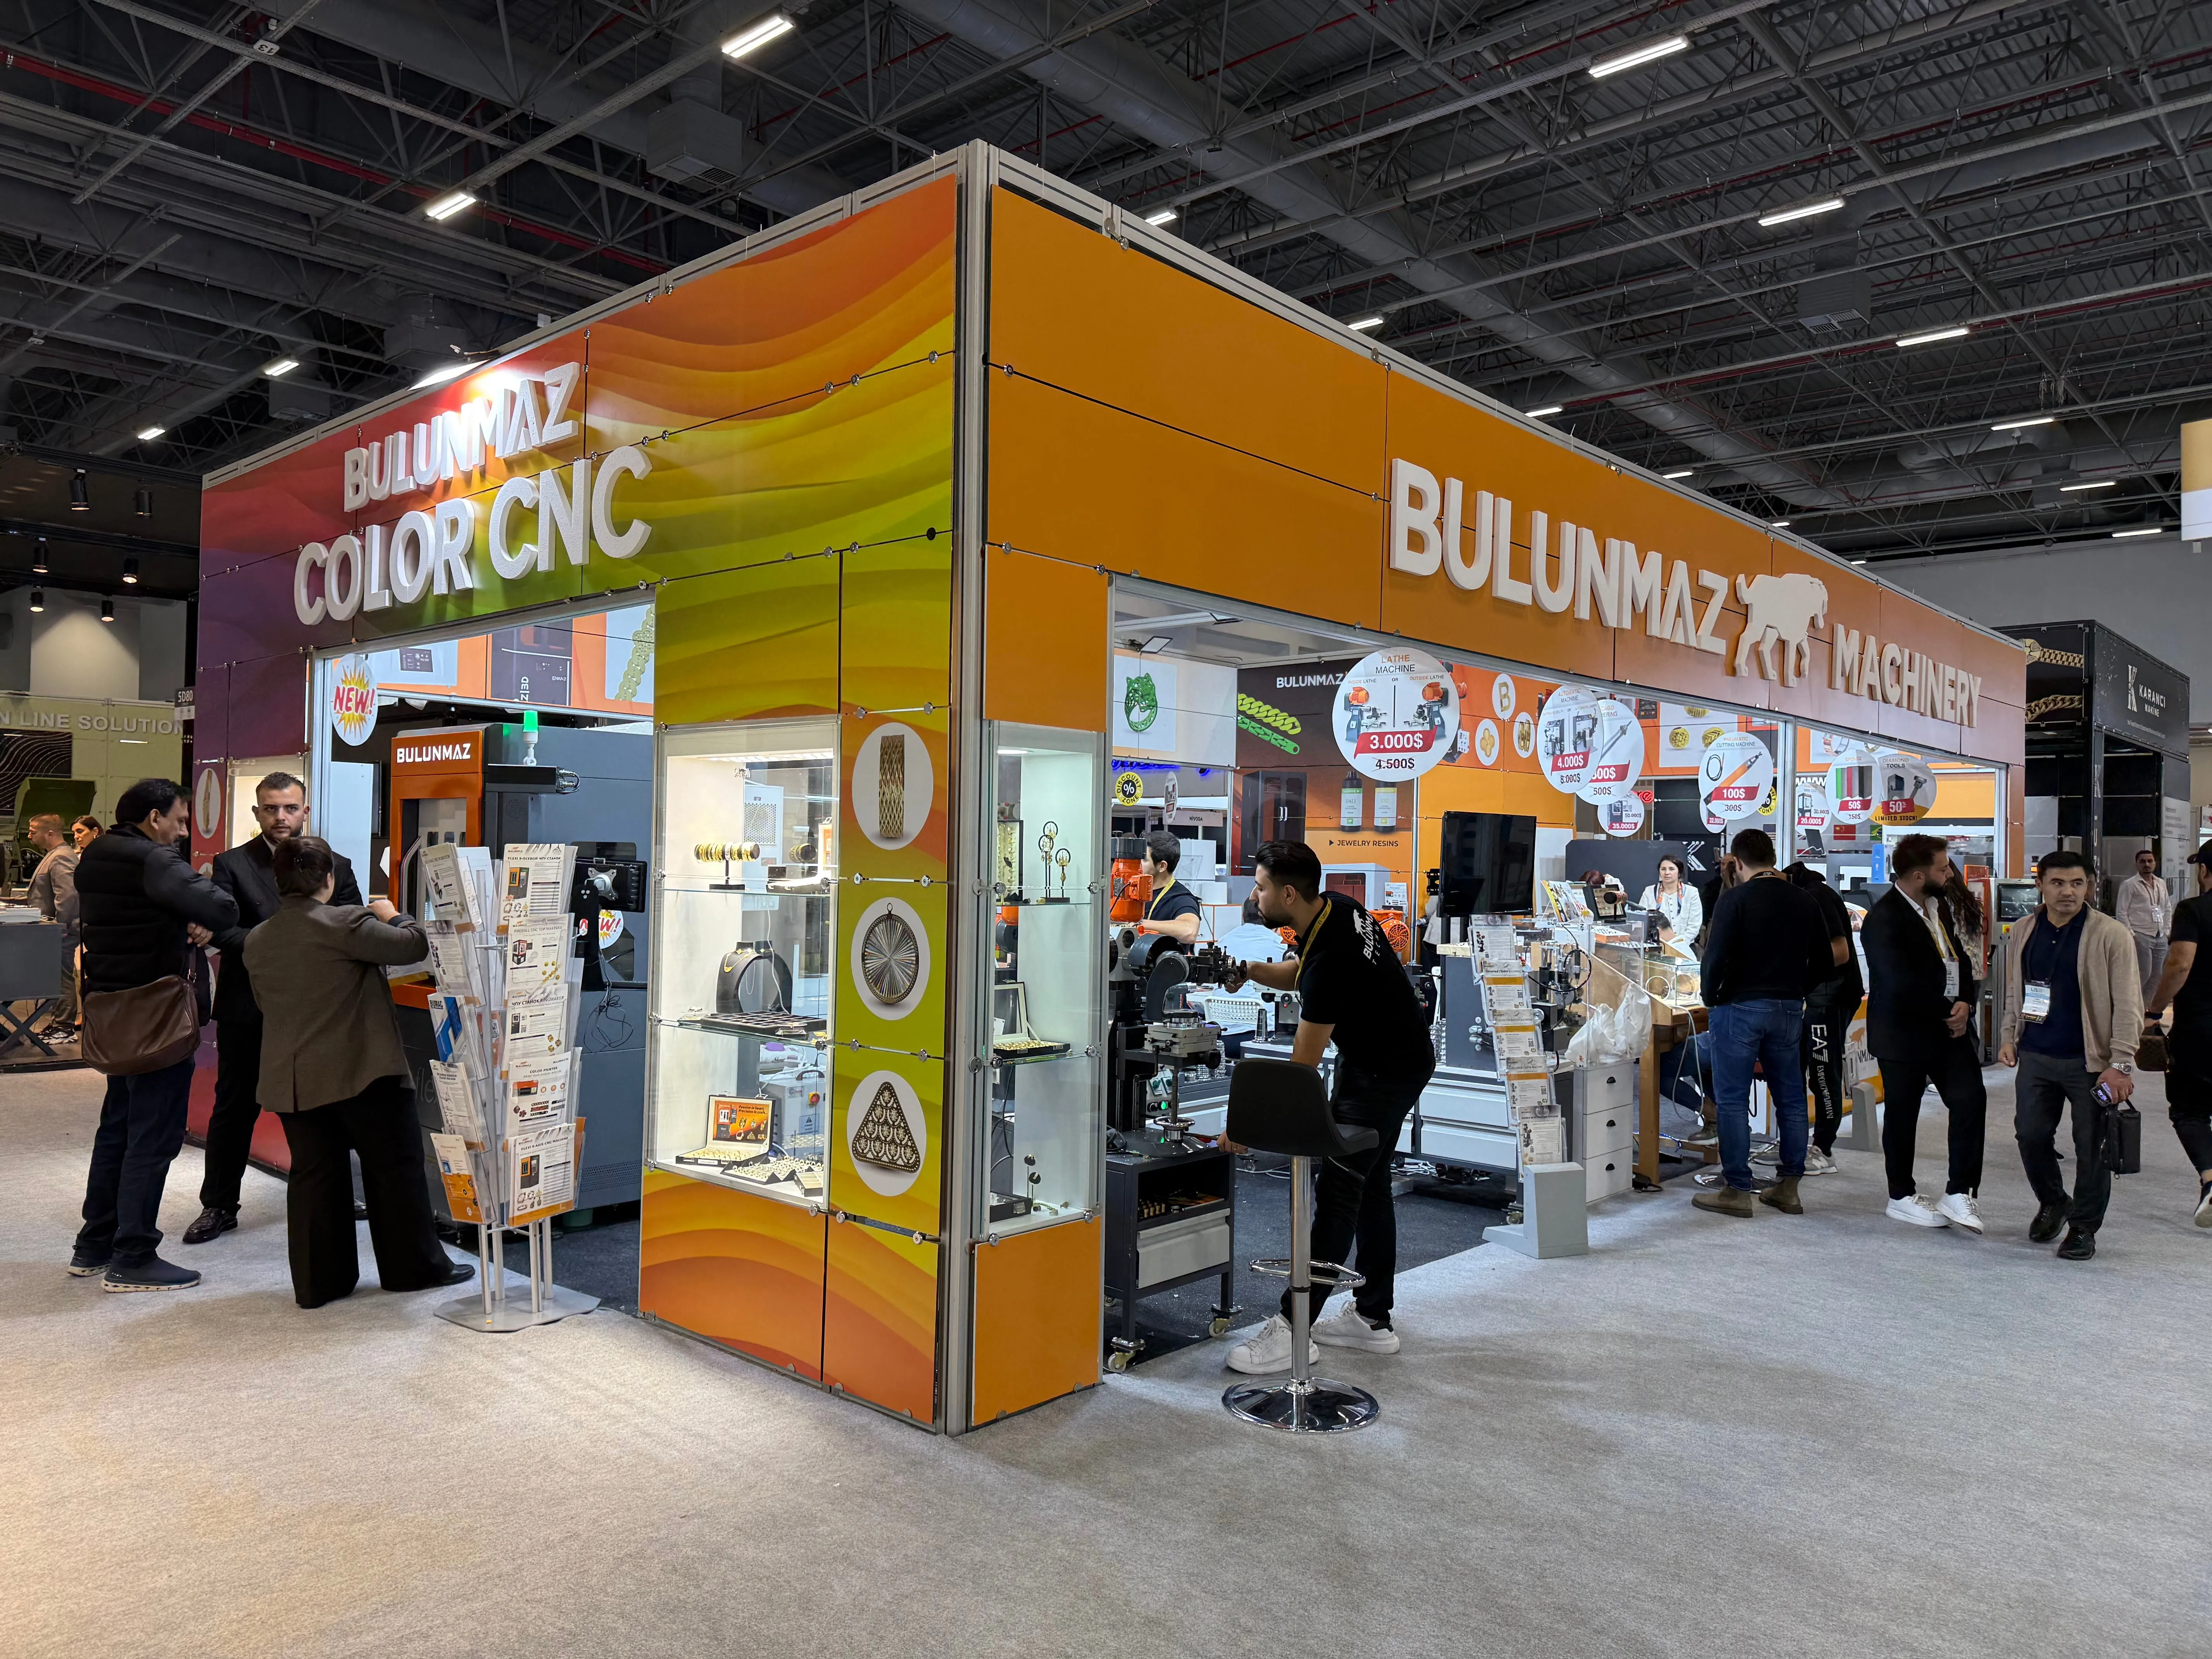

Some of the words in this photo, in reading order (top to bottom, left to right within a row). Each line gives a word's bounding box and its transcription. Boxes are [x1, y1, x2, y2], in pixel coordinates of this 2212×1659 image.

[344, 362, 580, 512] BULUNMAZ
[294, 498, 475, 625] COLOR
[489, 446, 653, 579] CNC
[1389, 458, 1729, 655] BULUNMAZ
[1830, 623, 1982, 728] MACHINERY
[1381, 654, 1410, 663] LATHE
[1375, 665, 1415, 674] MACHINE
[1276, 673, 1343, 689] BULUNMAZ
[333, 685, 375, 715] NEW!
[1558, 689, 1581, 697] AUTOMATIC
[2139, 684, 2166, 708] KARANCI
[19, 712, 70, 729] LINE
[1370, 732, 1424, 750] 3.000$
[397, 743, 471, 763] BULUNMAZ
[1557, 754, 1584, 768] 4.000$
[1375, 758, 1415, 770] 4.500$
[1117, 774, 1141, 793] DISCOUNT
[1593, 787, 1611, 795] 500$
[1122, 794, 1139, 804] ZONE
[1723, 788, 1745, 799] 100$
[1848, 800, 1861, 809] 50$
